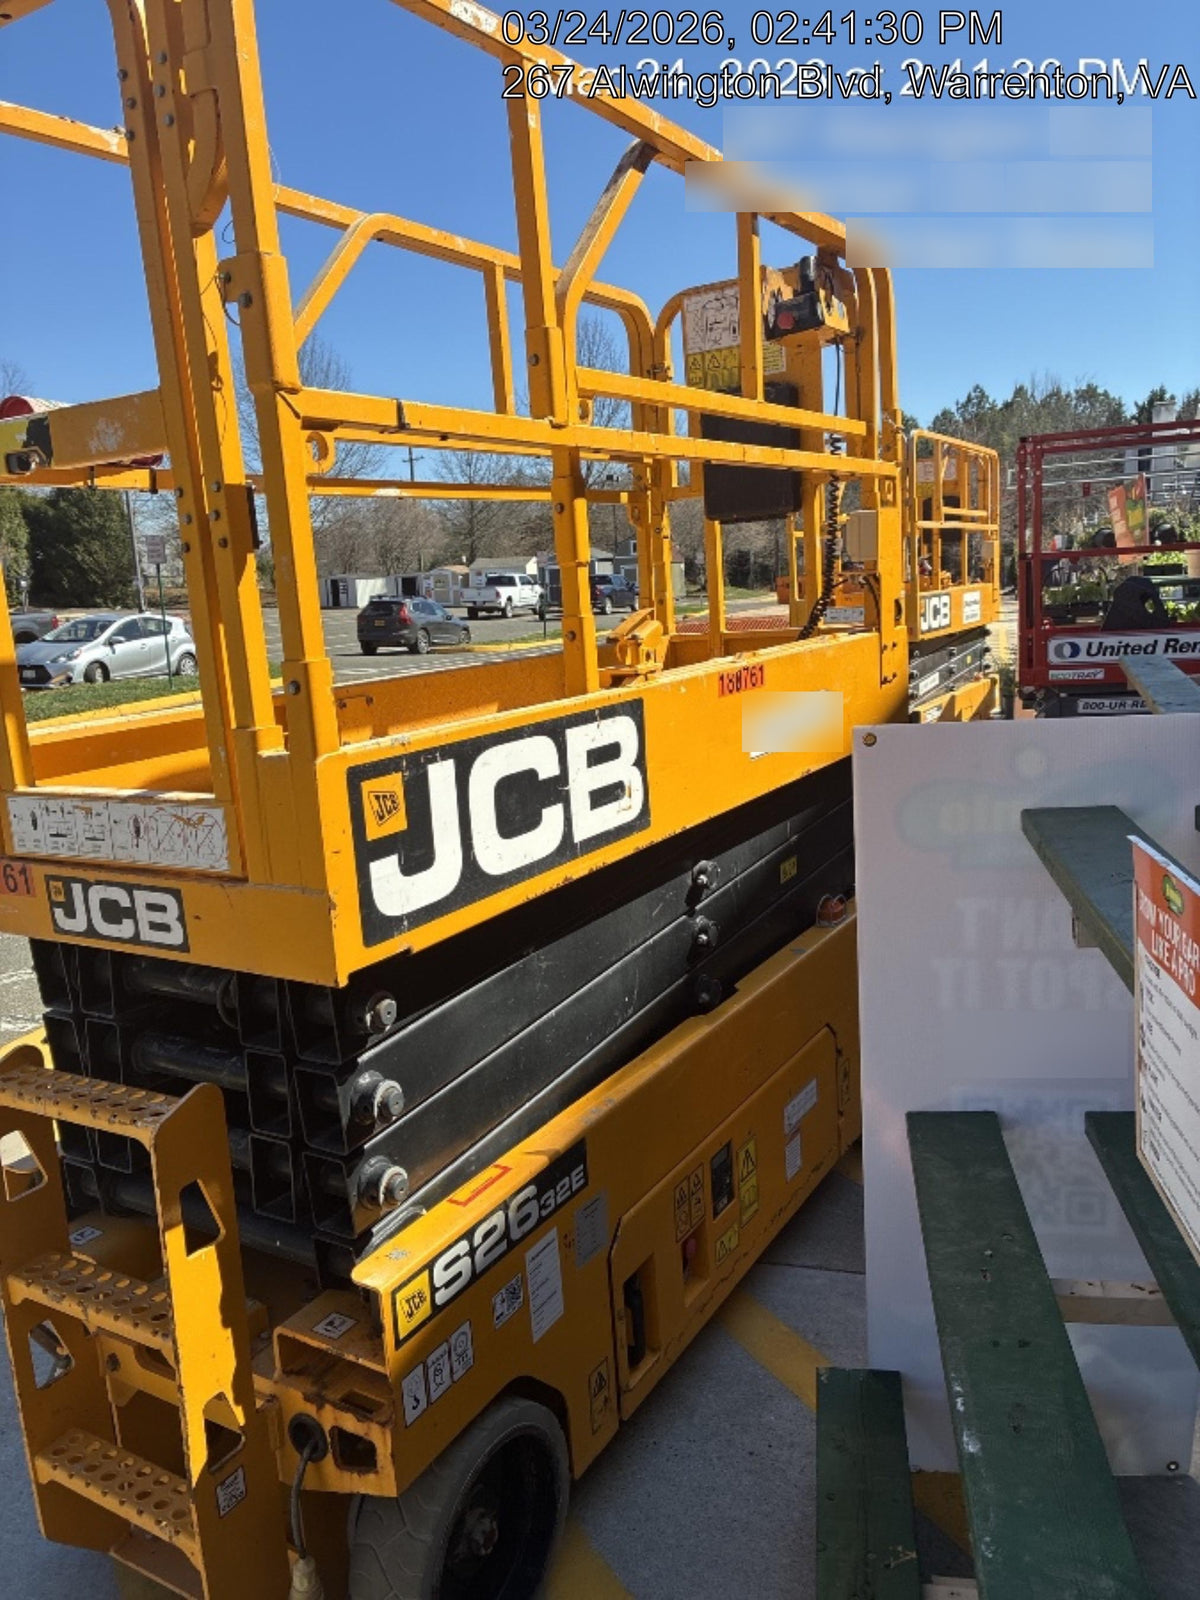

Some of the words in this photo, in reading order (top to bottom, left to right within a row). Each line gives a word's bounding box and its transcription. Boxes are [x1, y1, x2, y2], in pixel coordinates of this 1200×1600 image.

[1086, 640, 1158, 657] United
[368, 714, 644, 917] JCB
[3, 863, 31, 895] 61
[53, 883, 184, 946] JCB
